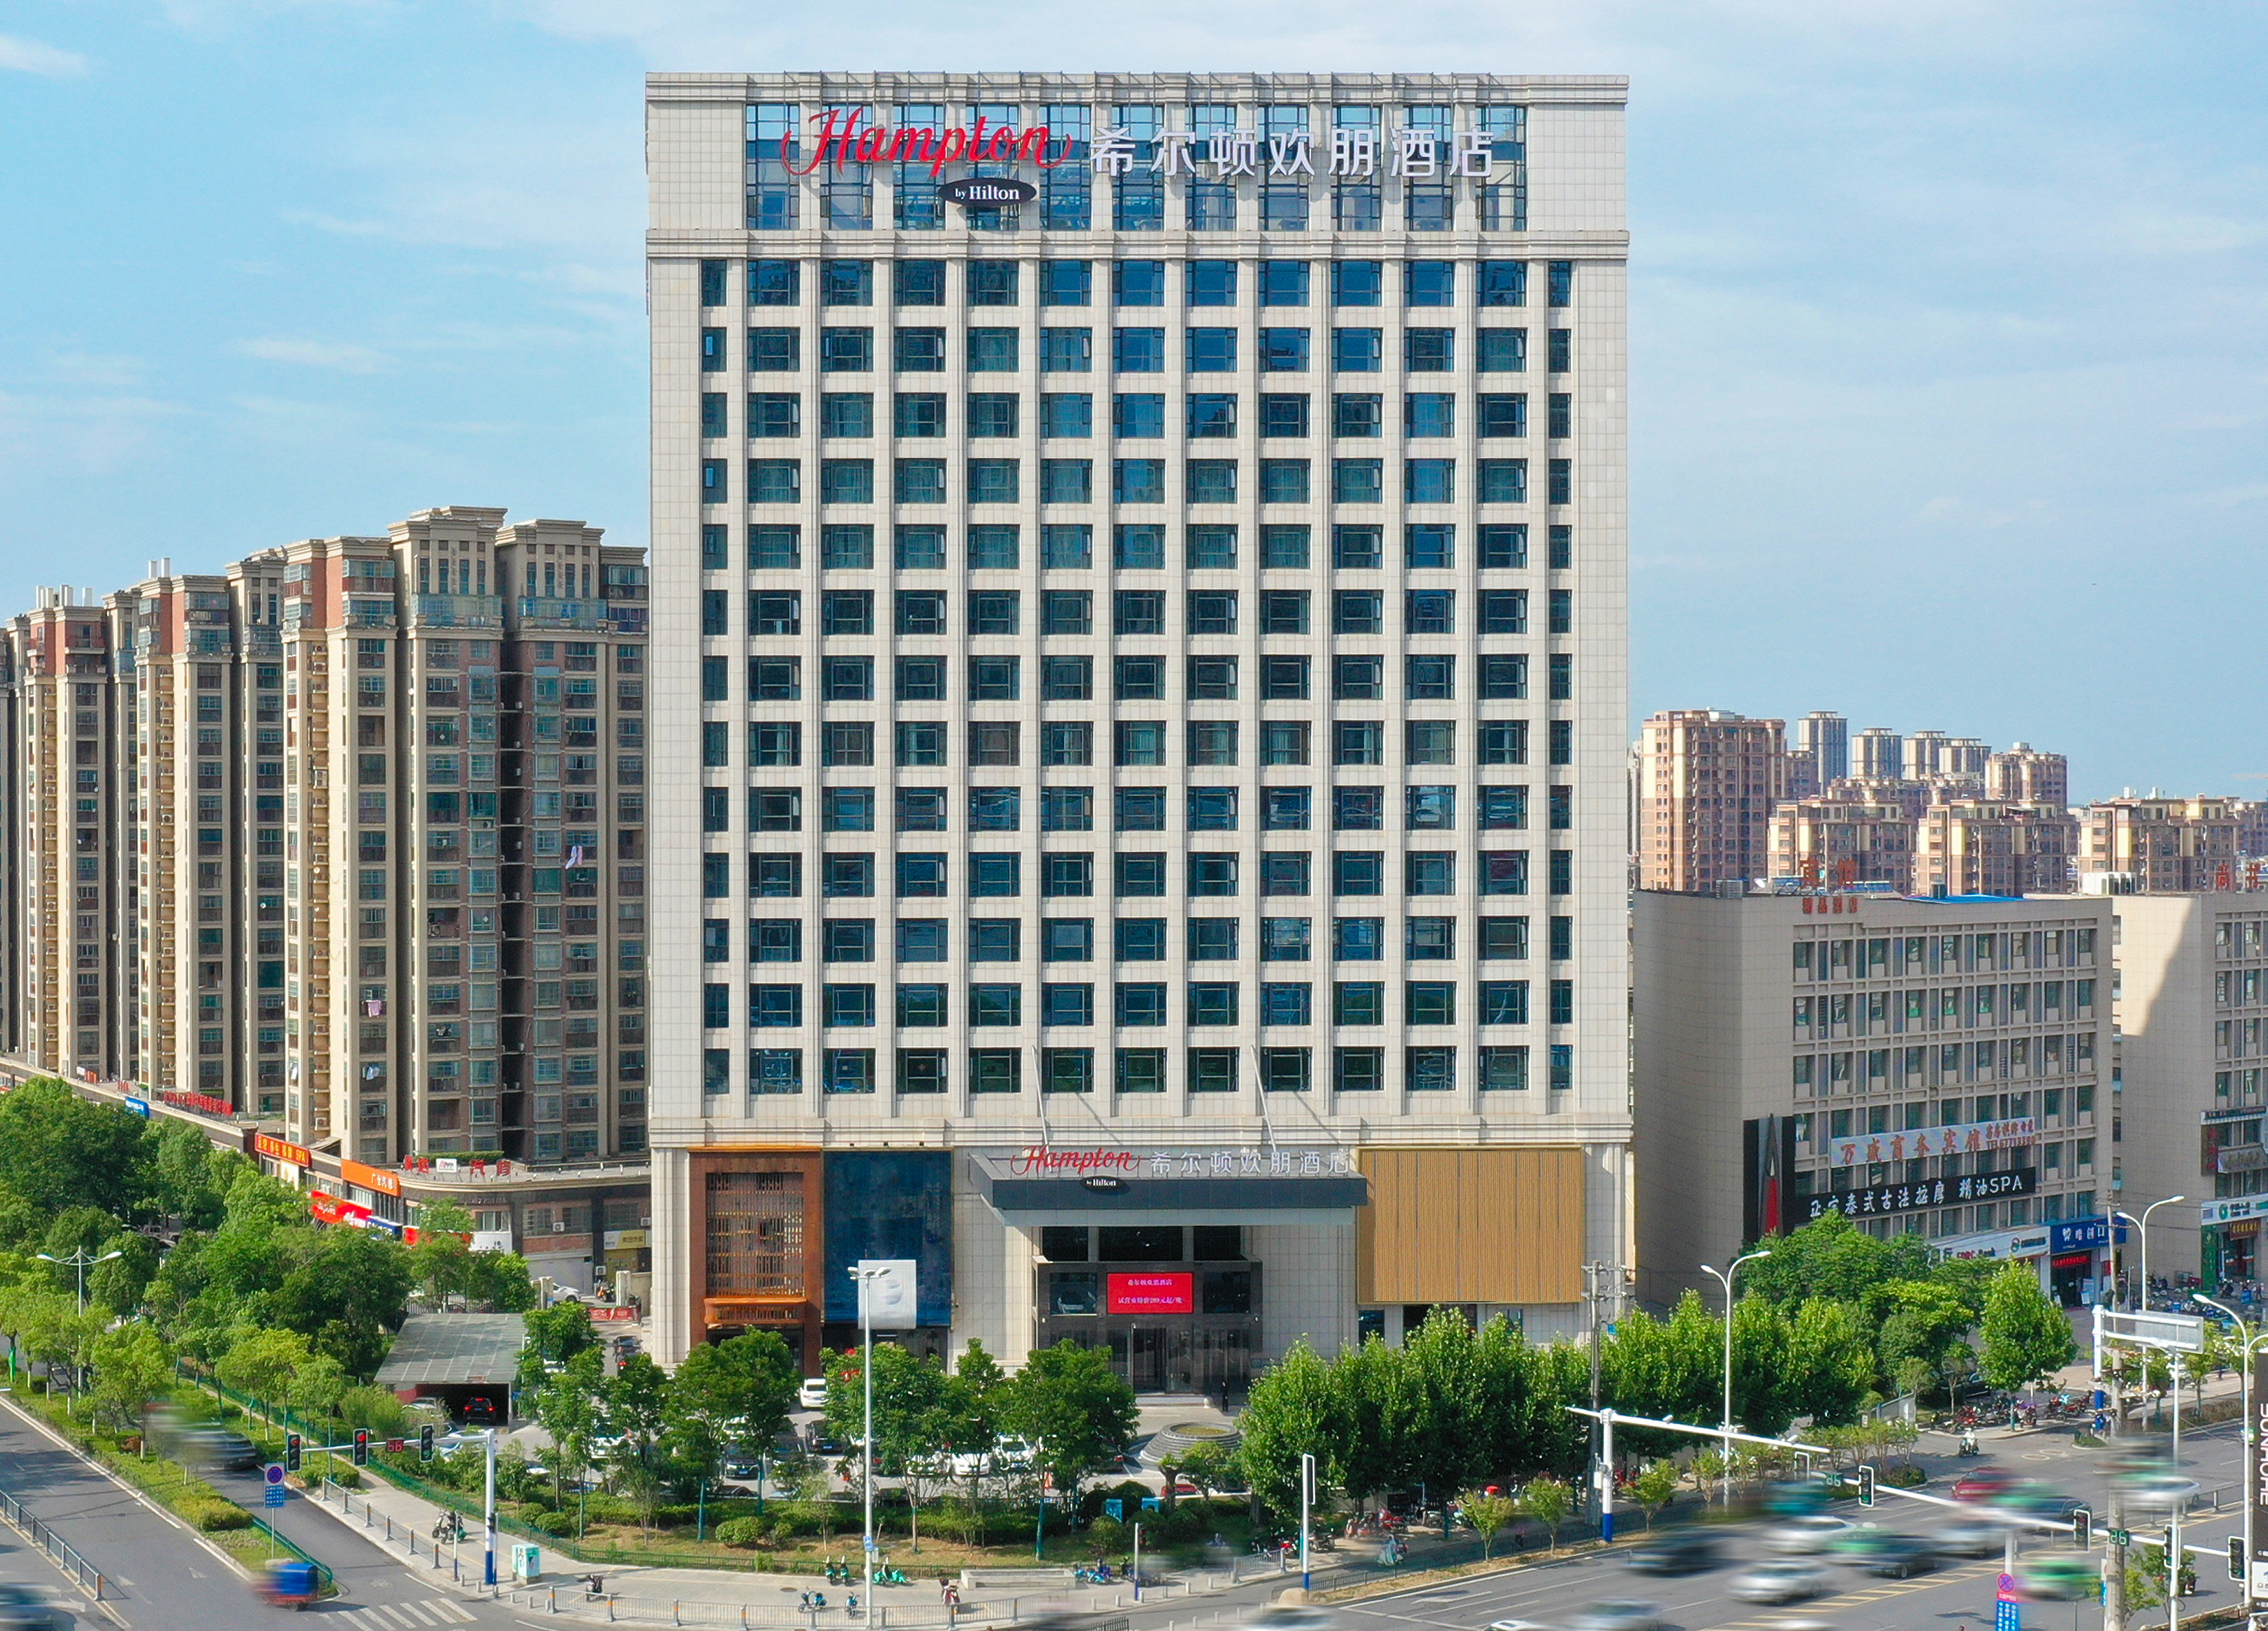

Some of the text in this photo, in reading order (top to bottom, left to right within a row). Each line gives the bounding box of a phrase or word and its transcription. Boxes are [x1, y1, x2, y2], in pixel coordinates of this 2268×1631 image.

[780, 107, 1072, 177] Hampton
[1090, 127, 1494, 177] 希尔顿欢朋酒店
[955, 186, 1019, 200] by Hilton
[1011, 1144, 1141, 1175] Hampton
[1150, 1150, 1349, 1174] 希尔顿欢朋酒店
[2111, 1530, 2127, 1545] 26
